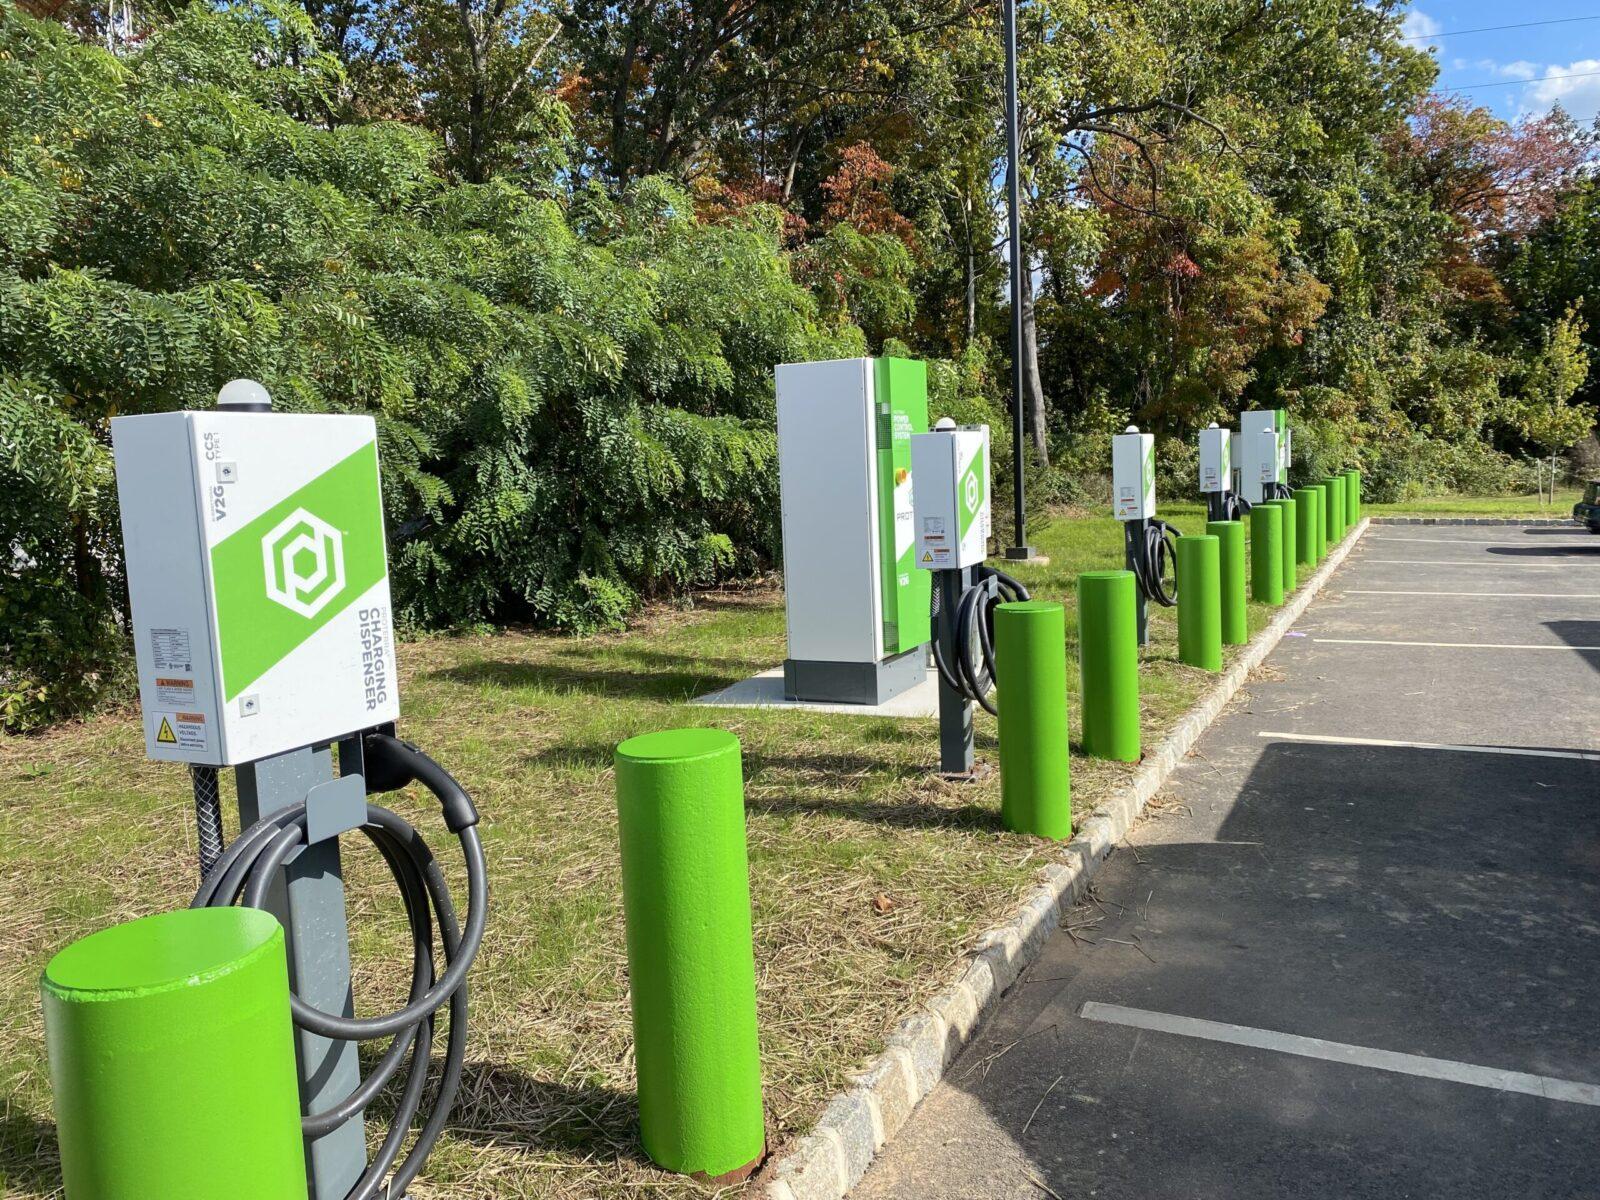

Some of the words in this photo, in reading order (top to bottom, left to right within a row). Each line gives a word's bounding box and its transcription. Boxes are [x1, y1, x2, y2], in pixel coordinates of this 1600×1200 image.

[204, 432, 215, 461] CCS
[213, 438, 221, 460] TYPE
[213, 485, 226, 521] V2G
[358, 609, 376, 711] DISPENSER
[370, 607, 387, 704] CHARGING
